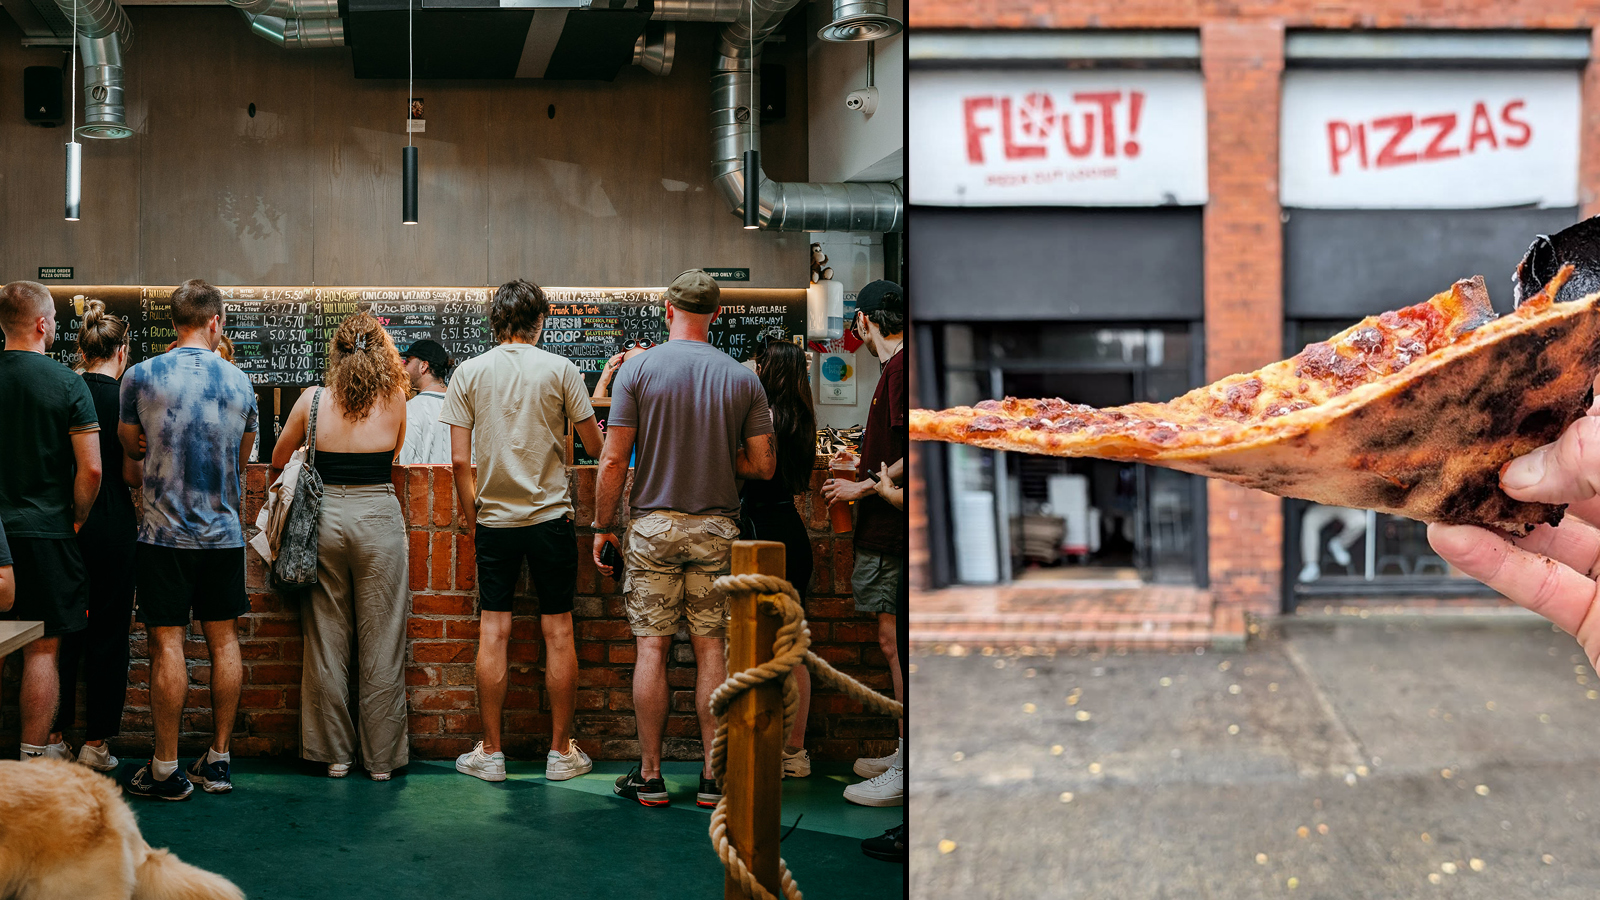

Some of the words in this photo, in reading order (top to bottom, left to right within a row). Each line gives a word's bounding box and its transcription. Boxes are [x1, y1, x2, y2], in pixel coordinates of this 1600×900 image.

[963, 91, 1144, 165] FLOUT!
[1327, 100, 1532, 175] PIZZAS
[285, 290, 303, 300] 5.50
[316, 289, 321, 302] 8
[323, 291, 340, 302] HOLY
[342, 290, 358, 302] GOAT
[362, 291, 399, 300] UNICORN
[402, 291, 430, 300] WIZARD
[464, 292, 486, 302] 6.20
[545, 291, 578, 302] PRICKLY
[142, 299, 147, 308] 2
[288, 303, 307, 314] 7.70
[315, 303, 321, 314] 9
[324, 303, 358, 314] BULLHOUSE
[464, 304, 482, 314] 7.50
[549, 304, 570, 315] Frank
[570, 304, 584, 316] The
[584, 304, 600, 315] Tank
[640, 306, 660, 317] 6.90
[749, 305, 787, 315] AVAILABLE
[142, 312, 147, 321] 3
[285, 316, 304, 329] 5.70
[314, 315, 323, 326] 10
[546, 317, 582, 330] FRESH
[642, 319, 659, 330] 5.00
[740, 316, 784, 326] TAKEAWAY!
[142, 327, 148, 337] 4
[229, 332, 257, 340] LAGER
[314, 328, 322, 340] 11
[463, 328, 481, 338] 5.30
[544, 330, 581, 342] HOOP
[730, 334, 746, 346] OFF
[142, 342, 148, 352] 5
[291, 343, 312, 355] 6.50
[314, 342, 324, 353] 12
[568, 344, 600, 356] SMUGGLER
[290, 356, 310, 369] 6.20
[315, 358, 325, 370] 13
